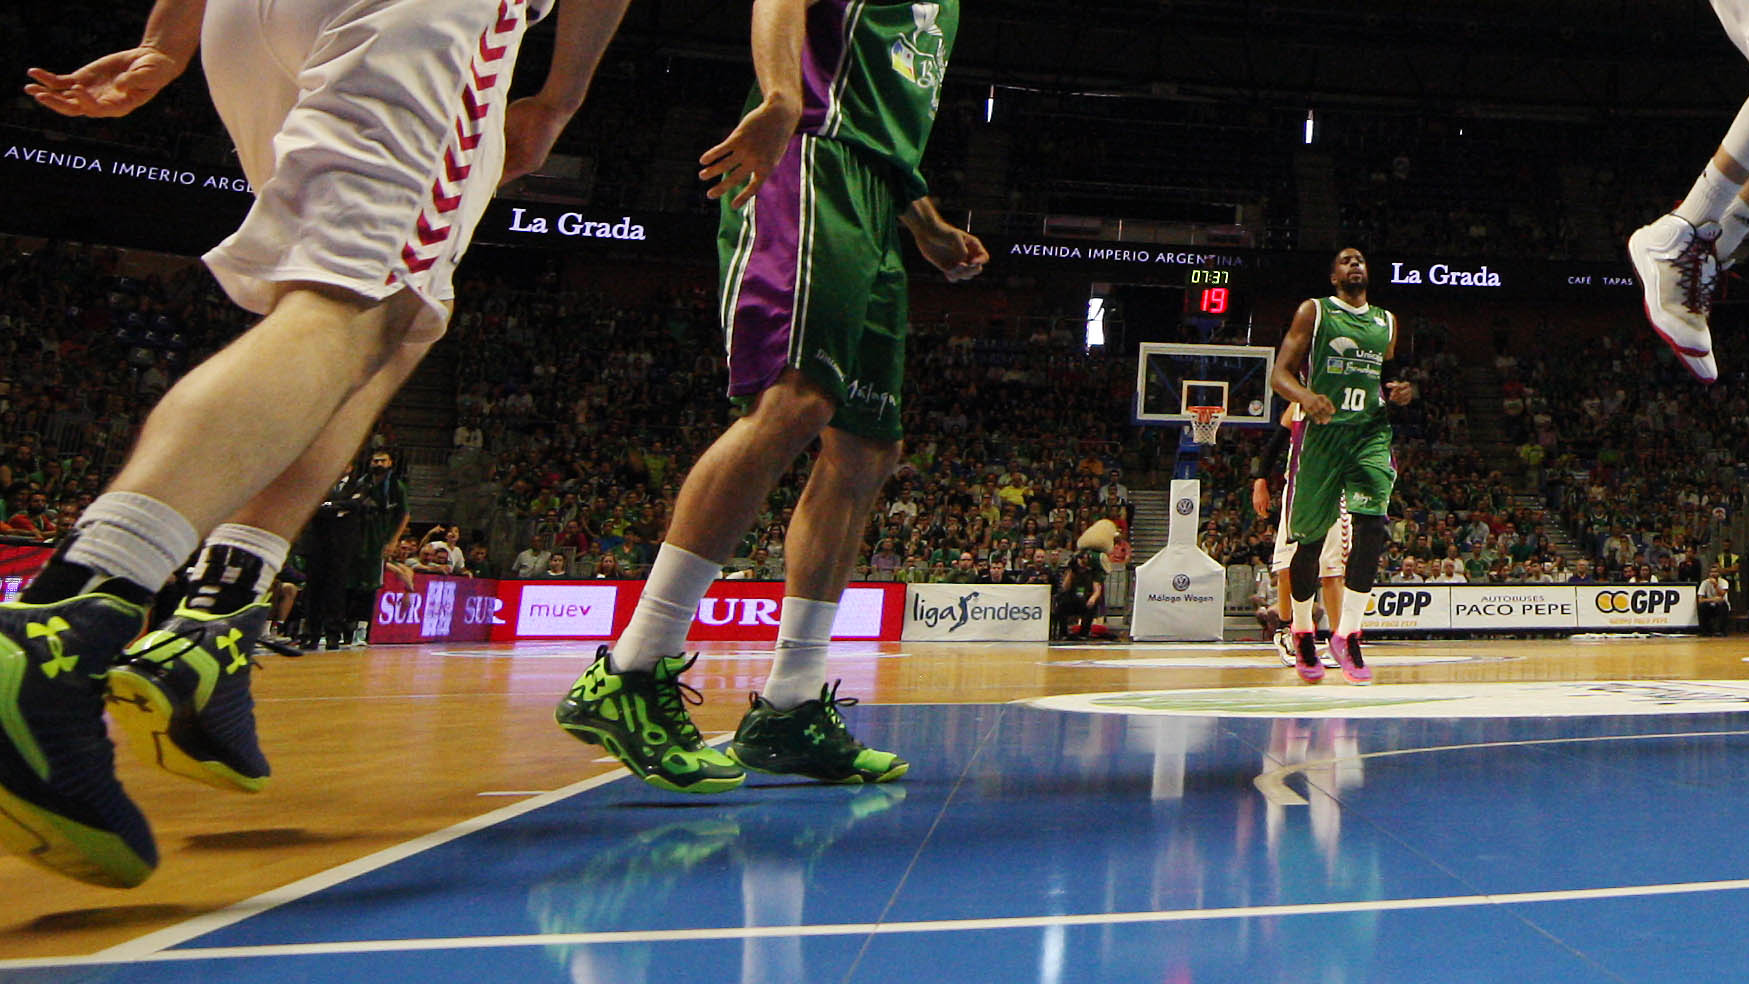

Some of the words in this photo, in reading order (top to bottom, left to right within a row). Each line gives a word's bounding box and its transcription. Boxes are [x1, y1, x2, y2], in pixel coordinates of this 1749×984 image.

[4, 145, 102, 172] AVENIDA
[112, 161, 196, 185] IMPERIO
[509, 208, 549, 234] La
[557, 212, 647, 241] Grada
[1010, 243, 1082, 259] AVENIDA
[1087, 248, 1150, 263] IMPERIO
[1191, 269, 1229, 285] 07:37
[1391, 262, 1422, 284] La
[1428, 264, 1501, 287] Grada
[1200, 287, 1230, 314] 19
[1341, 387, 1366, 411] 10
[464, 597, 506, 624] SUR
[529, 602, 592, 617] muev
[697, 598, 781, 626] UR
[912, 593, 953, 629] liga
[970, 601, 1043, 621] endesa
[1456, 604, 1513, 616] PACO
[1522, 603, 1572, 615] PEPE
